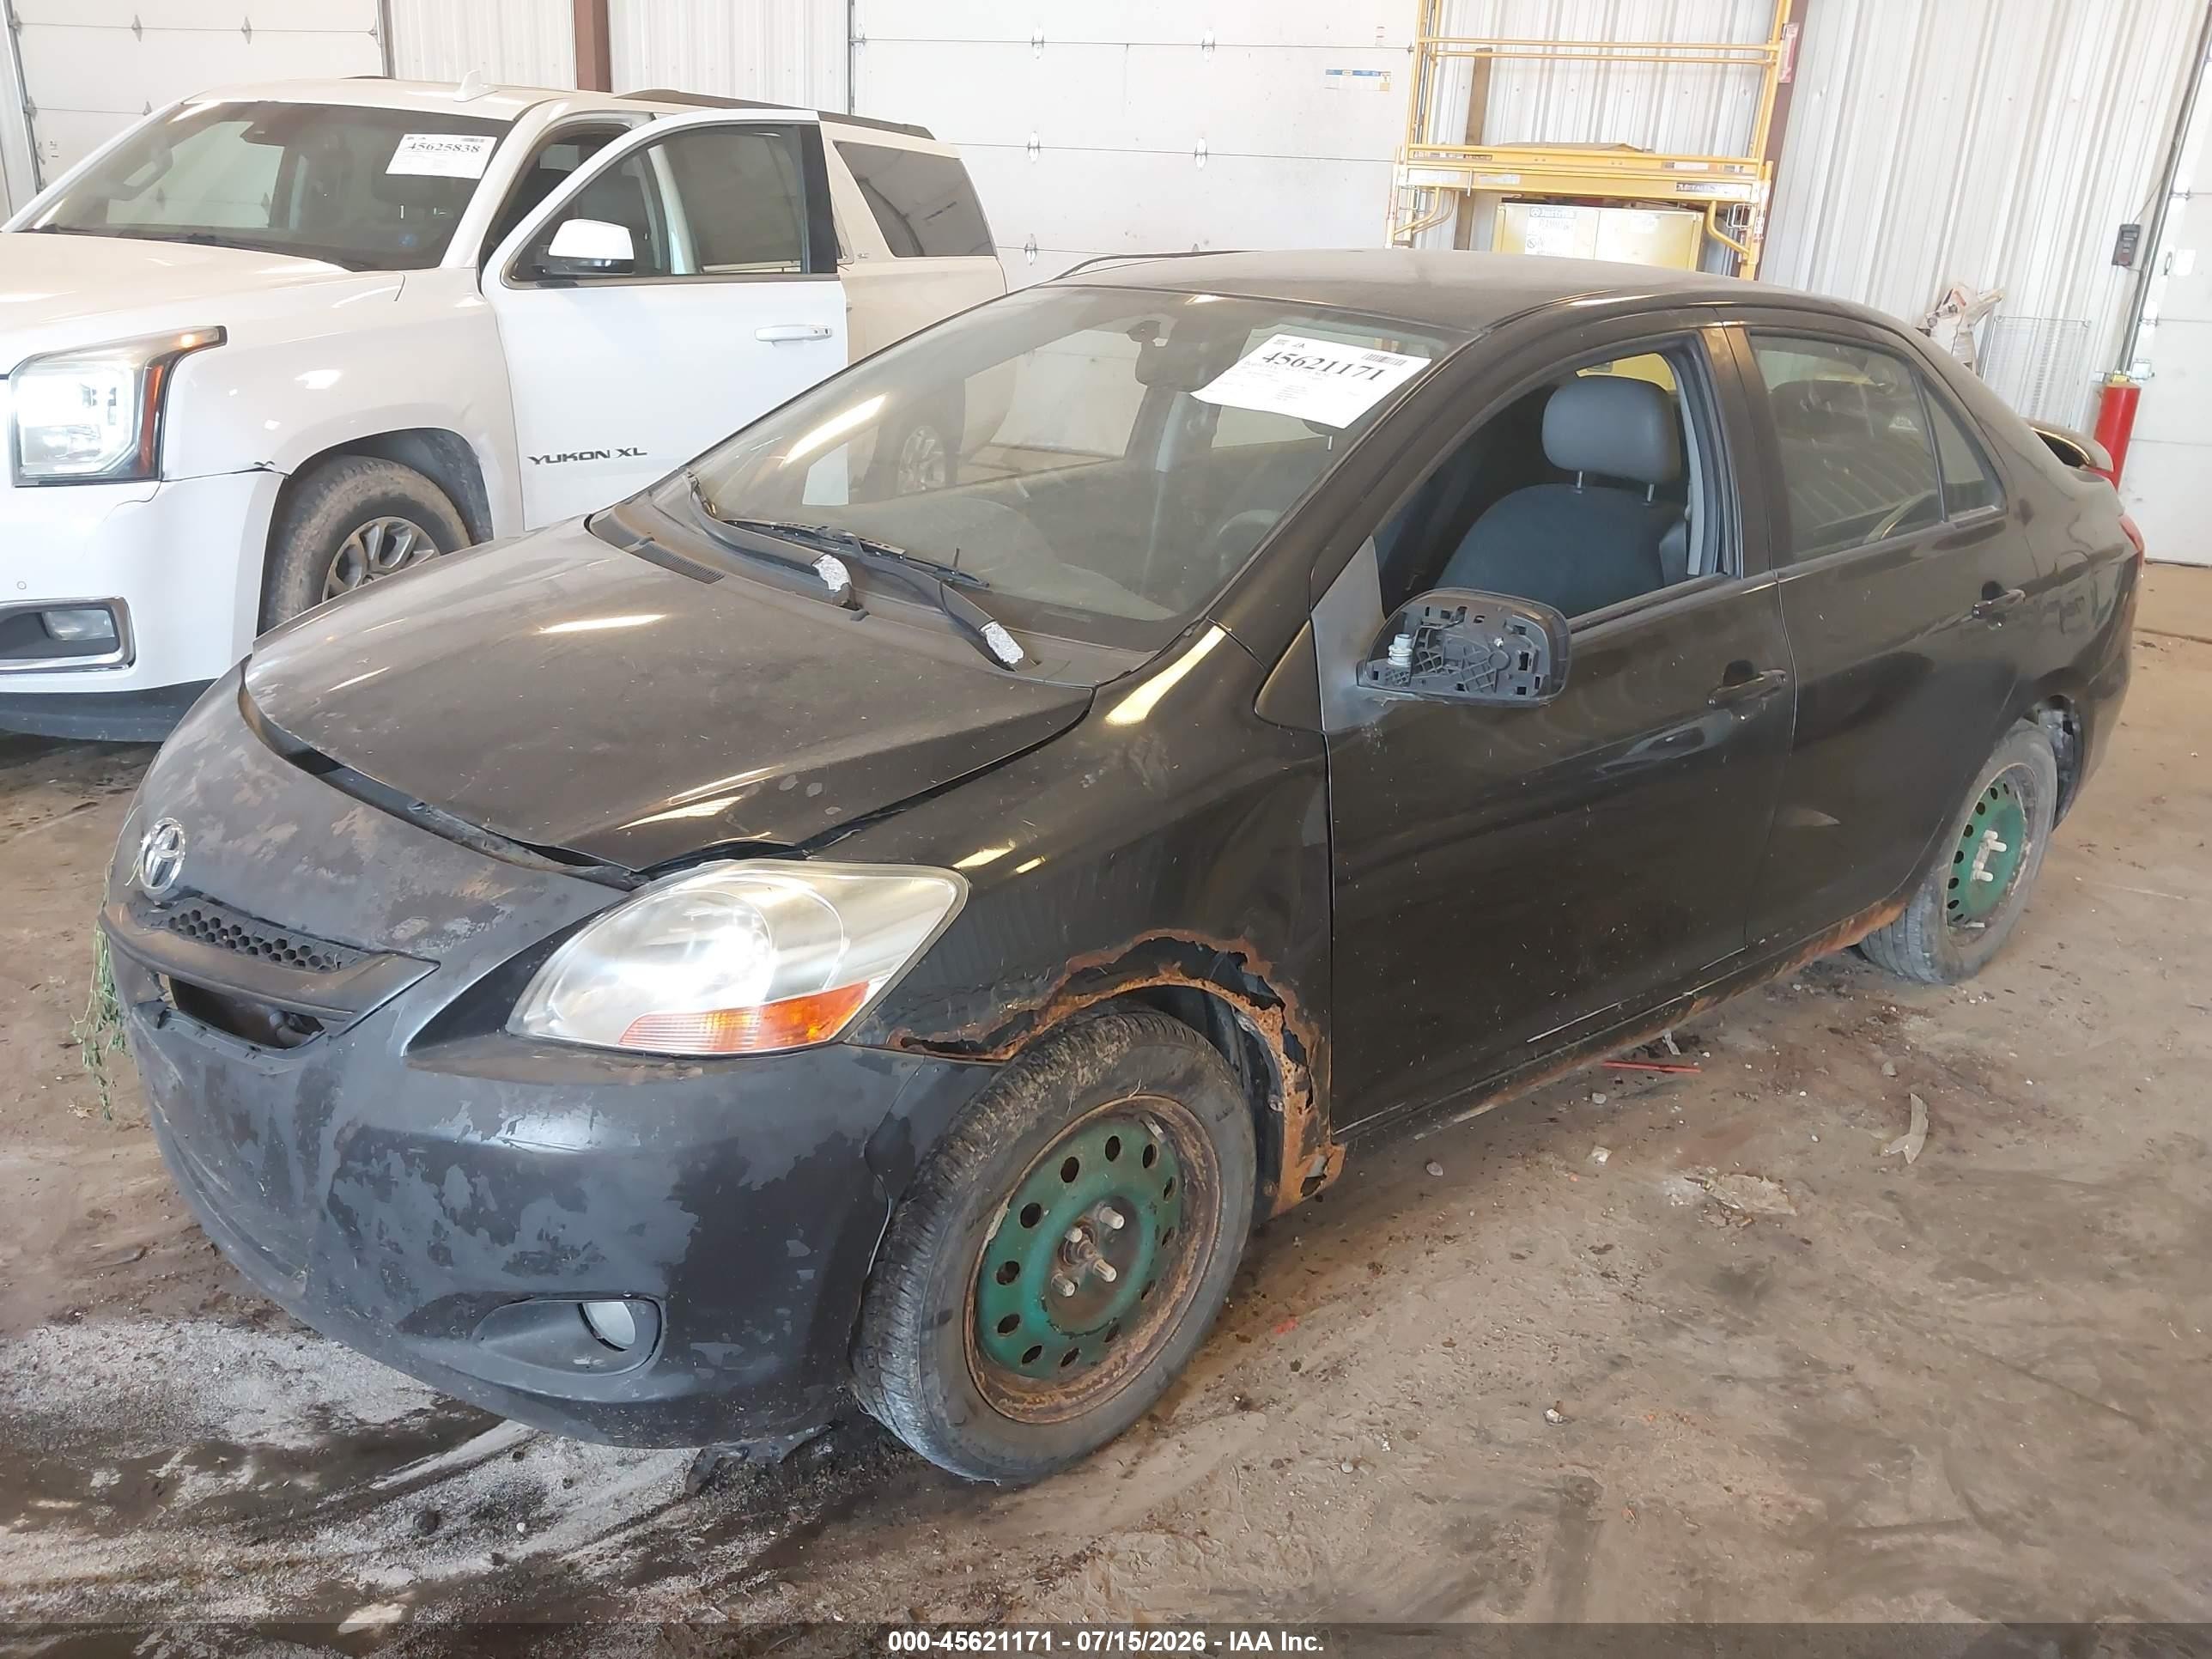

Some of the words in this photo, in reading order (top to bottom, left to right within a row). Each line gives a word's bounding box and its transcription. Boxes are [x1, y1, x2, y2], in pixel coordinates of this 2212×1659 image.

[406, 143, 482, 153] 45625838
[1262, 351, 1386, 380] 45621171
[527, 449, 611, 465] YUKON
[614, 447, 648, 458] XL
